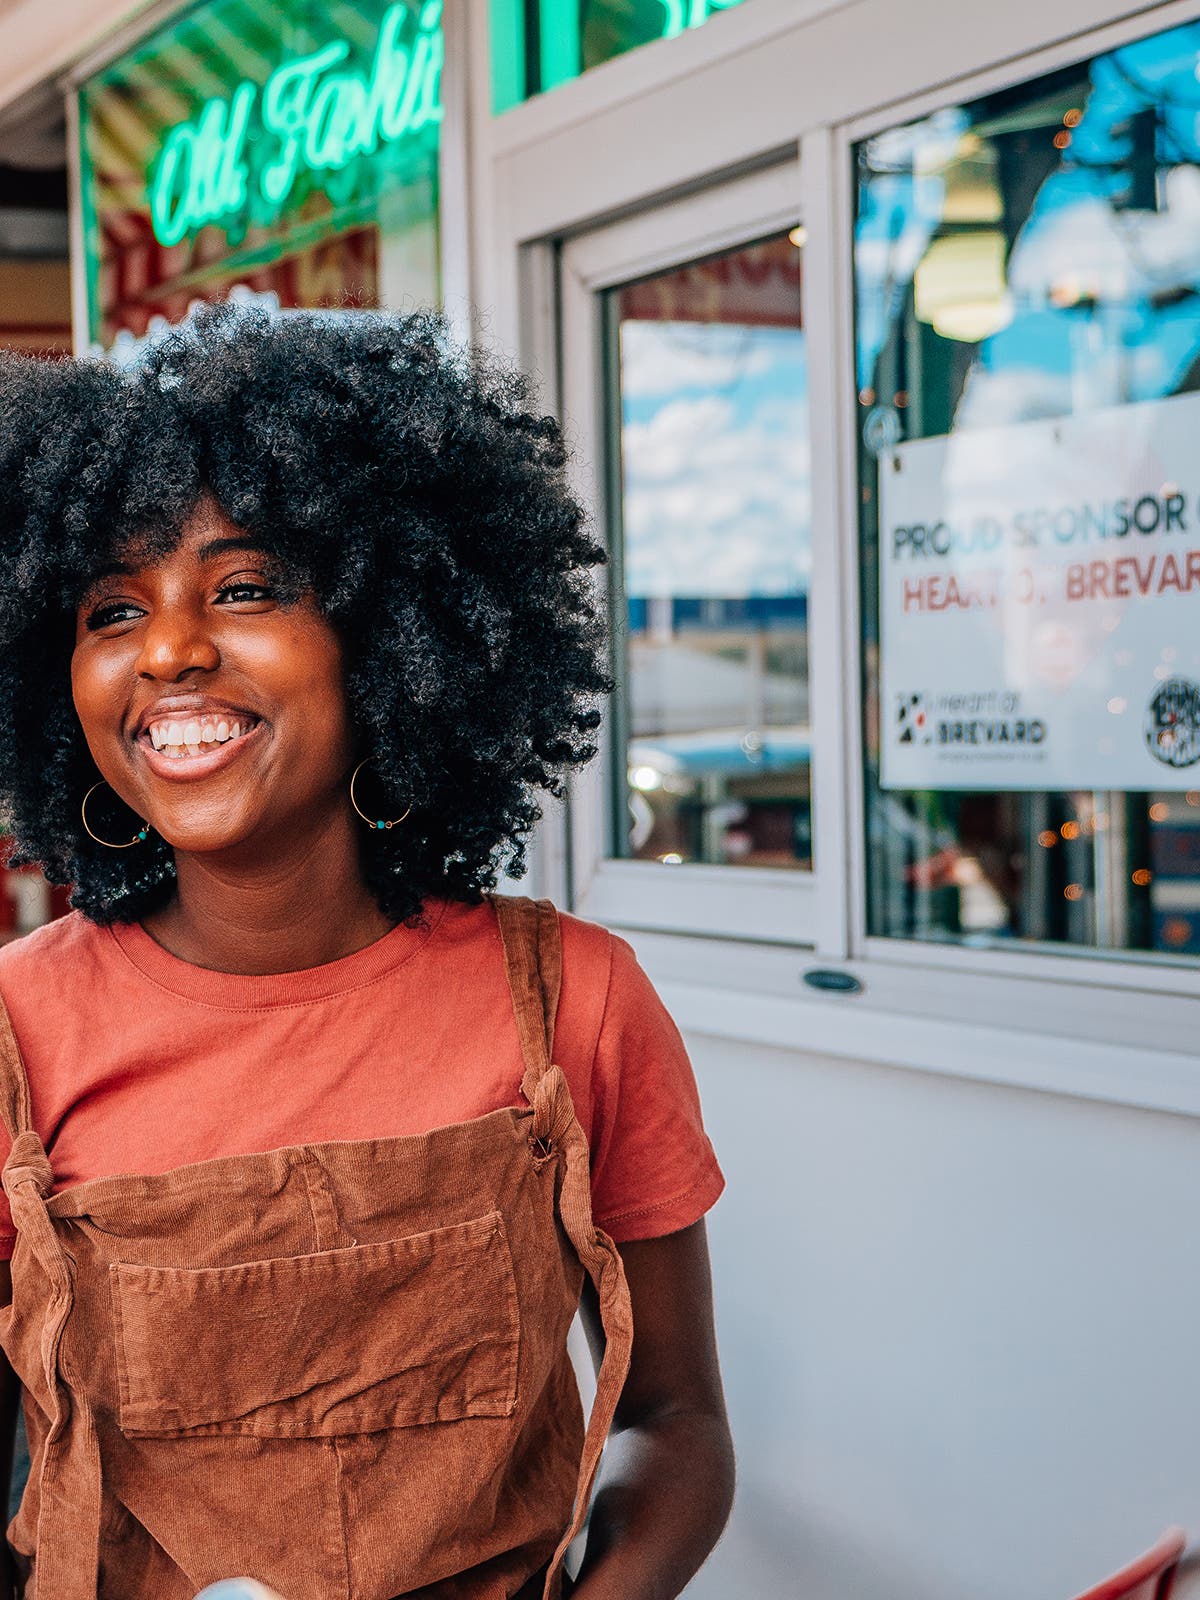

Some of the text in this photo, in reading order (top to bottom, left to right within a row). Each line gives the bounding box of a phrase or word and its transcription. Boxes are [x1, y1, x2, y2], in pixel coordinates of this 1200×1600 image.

[152, 80, 256, 246] Old
[892, 493, 1187, 560] PROUD SPONSOR
[1013, 566, 1050, 605] O
[938, 719, 1047, 744] BREVARD
